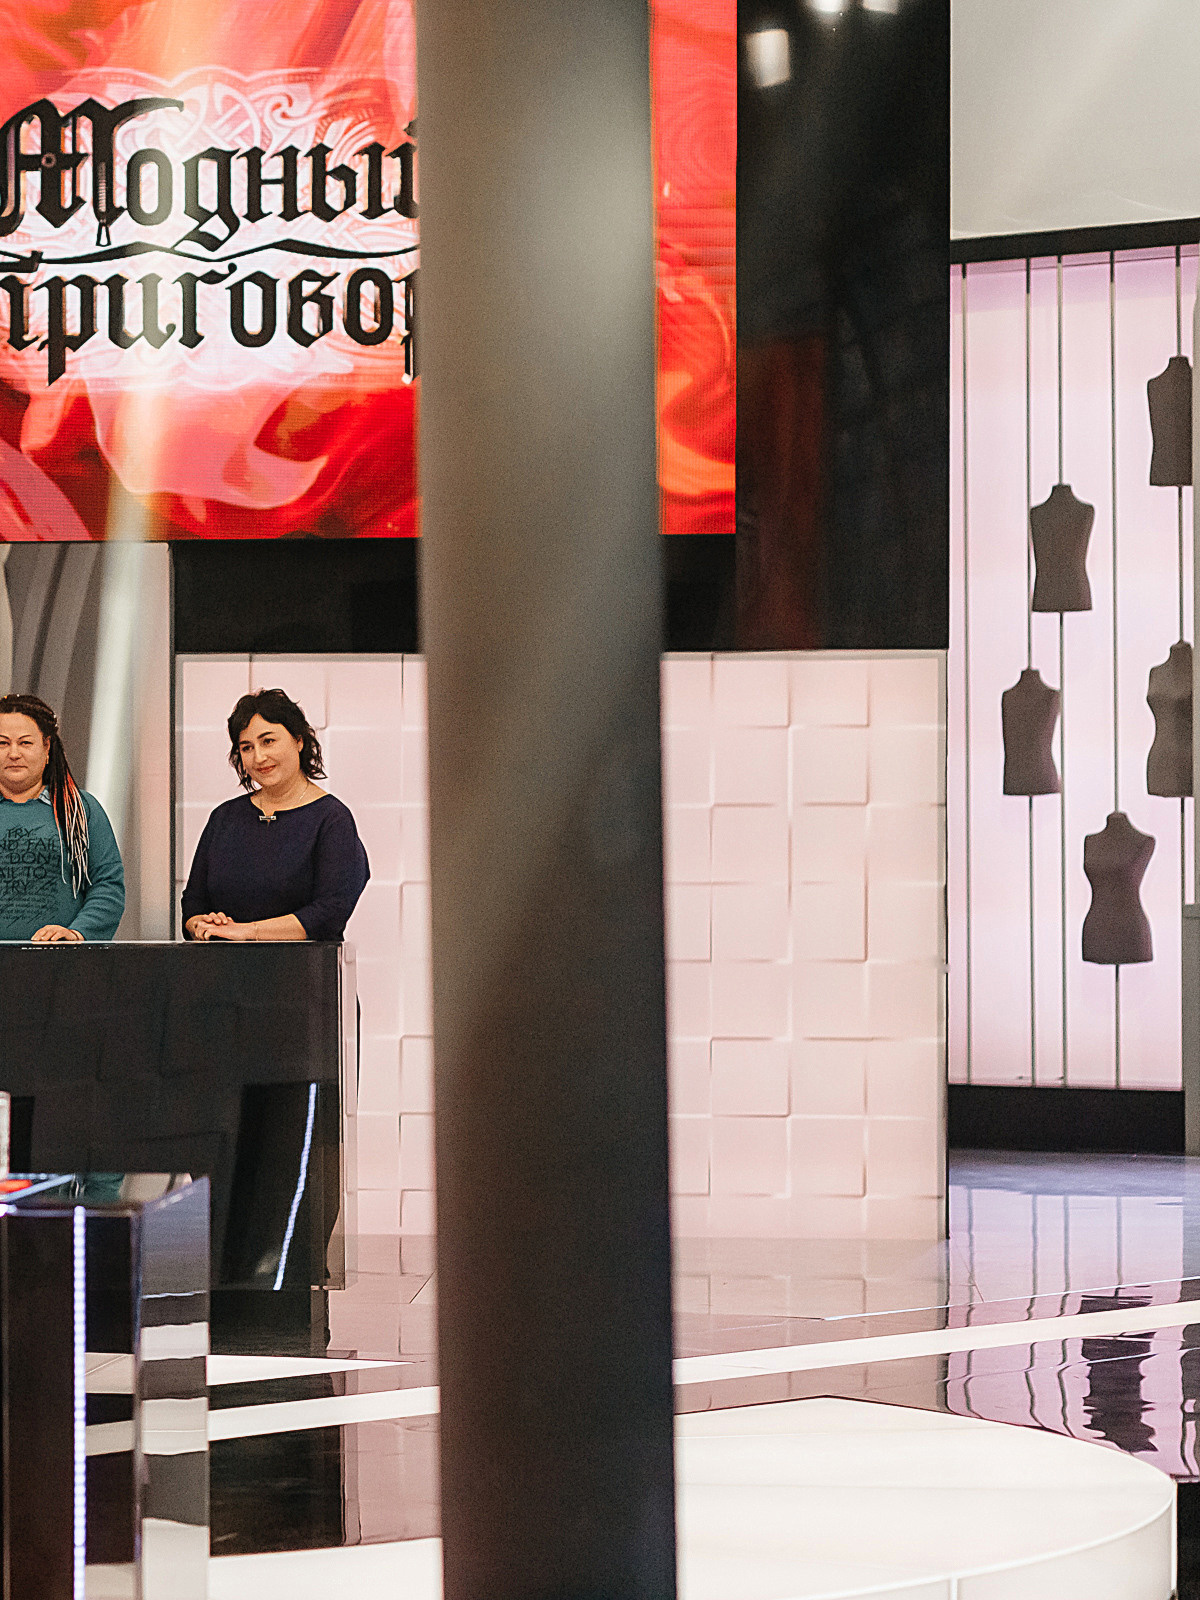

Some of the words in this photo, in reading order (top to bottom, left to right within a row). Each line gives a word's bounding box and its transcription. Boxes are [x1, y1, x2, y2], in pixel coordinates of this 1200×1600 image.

[6, 827, 32, 839] TRY
[26, 838, 59, 852] FAIL
[25, 866, 47, 879] TO
[4, 879, 31, 893] TRY
